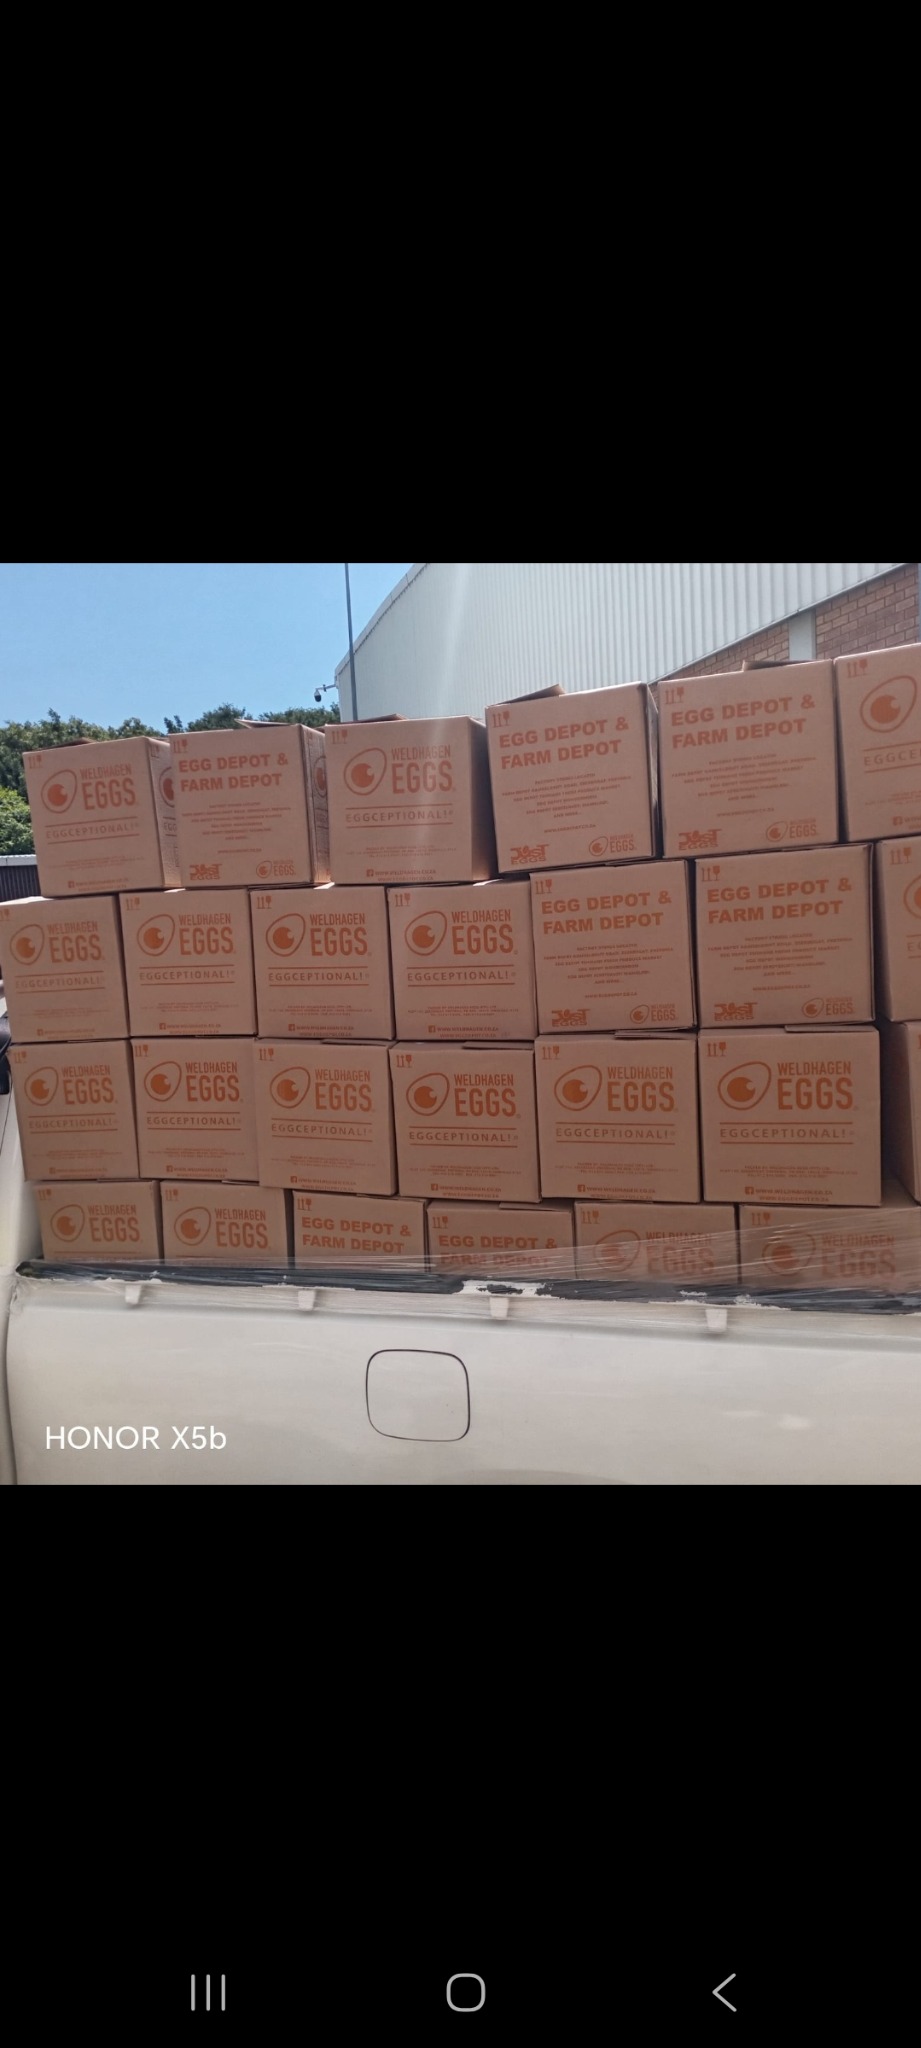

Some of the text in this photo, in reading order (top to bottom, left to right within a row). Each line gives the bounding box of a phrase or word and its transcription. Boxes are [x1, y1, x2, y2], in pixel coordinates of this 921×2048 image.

[671, 694, 816, 726] EGG DEPOT &
[500, 716, 629, 748] EGG DEPOT &
[672, 718, 807, 749] FARM DEPOT
[179, 752, 288, 773] EGG DEPOT &
[391, 745, 451, 760] WELDHAGEN
[501, 740, 622, 769] FARM DEPOT
[80, 764, 132, 780] WELDHAGEN
[392, 760, 453, 794] EGGS
[180, 773, 282, 792] FARM DEPOT
[82, 778, 137, 810] EGGS
[789, 824, 817, 839] EGGS
[610, 839, 635, 853] EGGS
[273, 864, 296, 876] EGGS
[707, 877, 852, 903] EGG DEPOT &
[541, 890, 672, 914] EGG DEPOT &
[708, 900, 843, 924] FARM DEPOT
[178, 913, 231, 926] WELDHAGEN
[310, 913, 365, 925] WELDHAGEN
[451, 909, 511, 923] WELDHAGEN
[543, 912, 664, 935] FARM DEPOT
[47, 921, 98, 934] WELDHAGEN
[48, 934, 102, 963] EGGS
[179, 926, 234, 955] EGGS
[310, 927, 368, 956] EGGS
[452, 923, 514, 955] EGGS
[651, 1009, 676, 1021] EGGS
[826, 1002, 853, 1016] EGGS
[62, 1065, 110, 1077] WELDHAGEN
[185, 1062, 238, 1073] WELDHAGEN
[315, 1069, 371, 1082] WELDHAGEN
[607, 1066, 673, 1079] WELDHAGEN
[777, 1061, 851, 1076] WELDHAGEN
[186, 1075, 240, 1102] EGGS
[454, 1074, 514, 1087] WELDHAGEN
[63, 1077, 114, 1105] EGGS
[315, 1082, 372, 1112] EGGS
[607, 1081, 675, 1112] EGGS
[777, 1077, 853, 1111] EGGS
[454, 1088, 517, 1117] EGGS
[88, 1204, 136, 1216] WELDHAGEN
[214, 1208, 266, 1221] WELDHAGEN
[89, 1217, 140, 1242] EGGS
[215, 1221, 268, 1249] EGGS
[302, 1217, 411, 1237] EGG DEPOT &
[302, 1234, 404, 1254] FARM DEPOT
[439, 1235, 557, 1249] EGG DEPOT &
